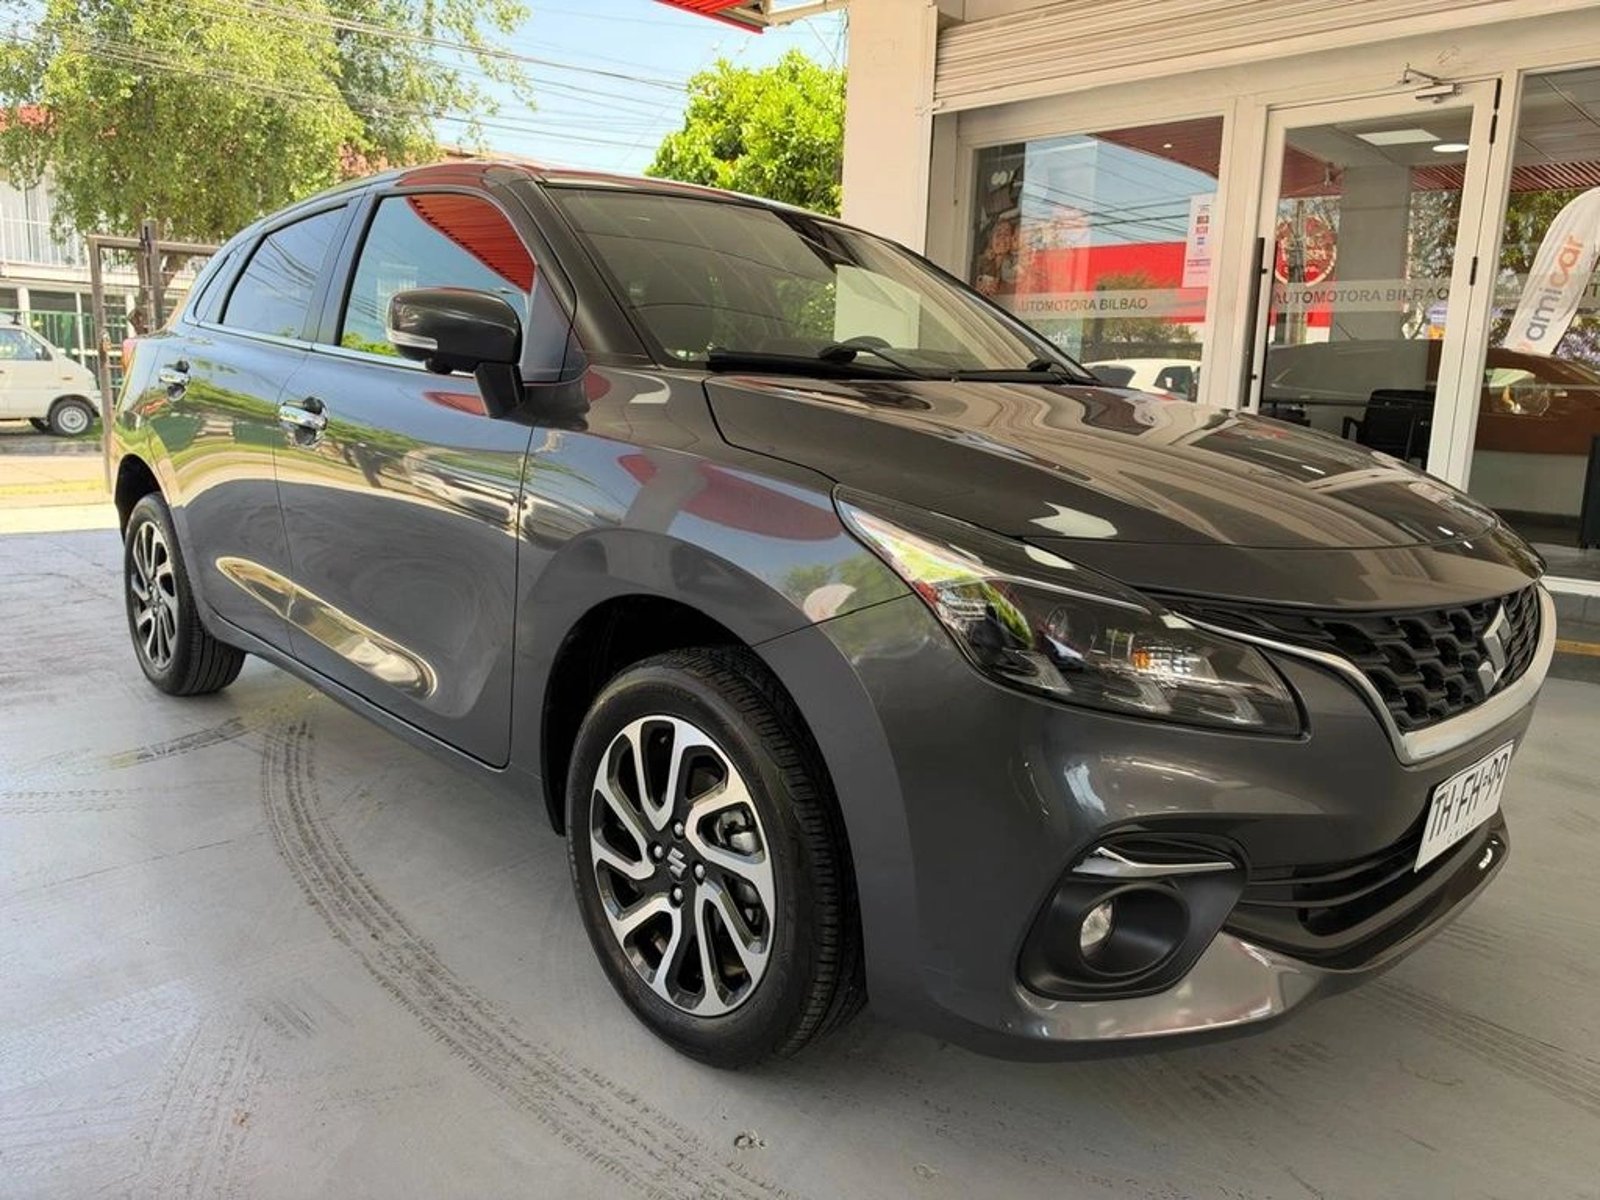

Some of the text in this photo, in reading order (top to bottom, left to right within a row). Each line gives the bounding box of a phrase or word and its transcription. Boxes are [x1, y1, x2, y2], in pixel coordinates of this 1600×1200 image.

[1385, 286, 1450, 302] BILBAO
[1525, 235, 1585, 341] amicar
[1018, 297, 1149, 313] UTOMOTORA BILBAO
